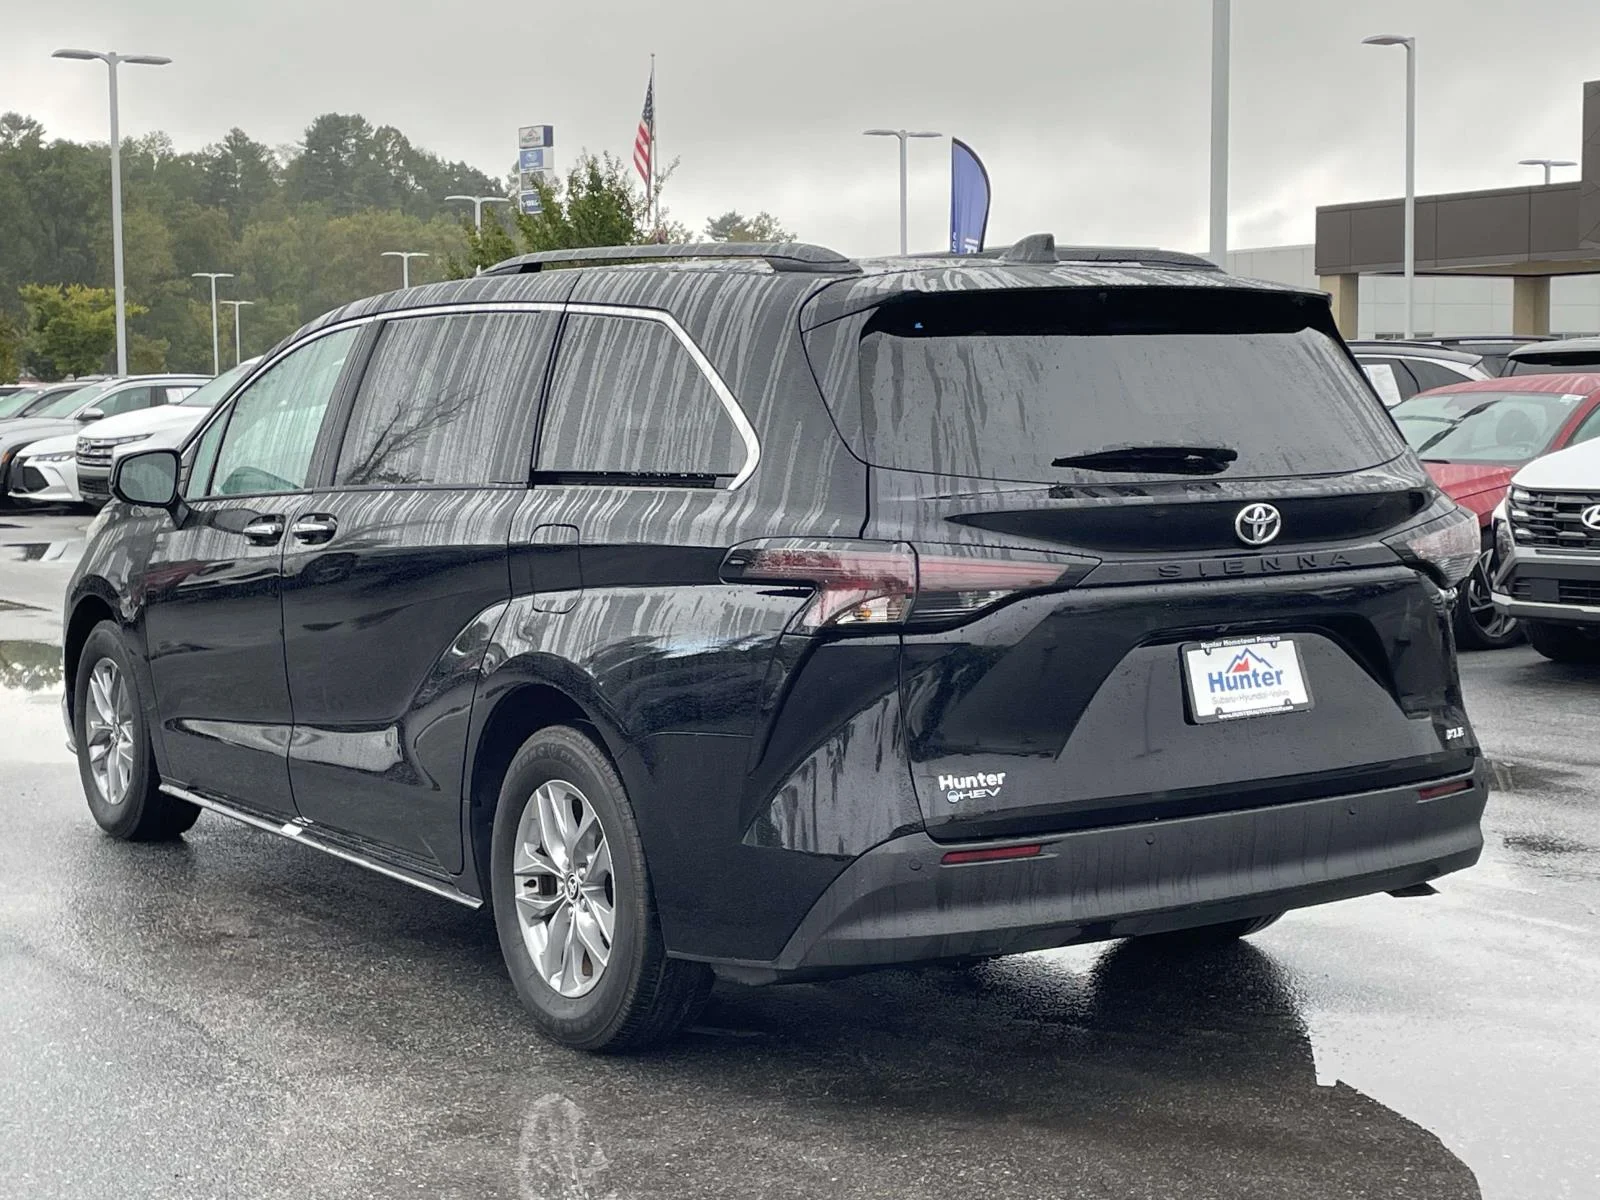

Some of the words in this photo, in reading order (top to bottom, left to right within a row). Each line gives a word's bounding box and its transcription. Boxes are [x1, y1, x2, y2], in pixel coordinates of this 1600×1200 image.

[1158, 552, 1352, 578] SIENNA
[1207, 668, 1283, 693] Hunter
[938, 772, 1006, 791] Hunter
